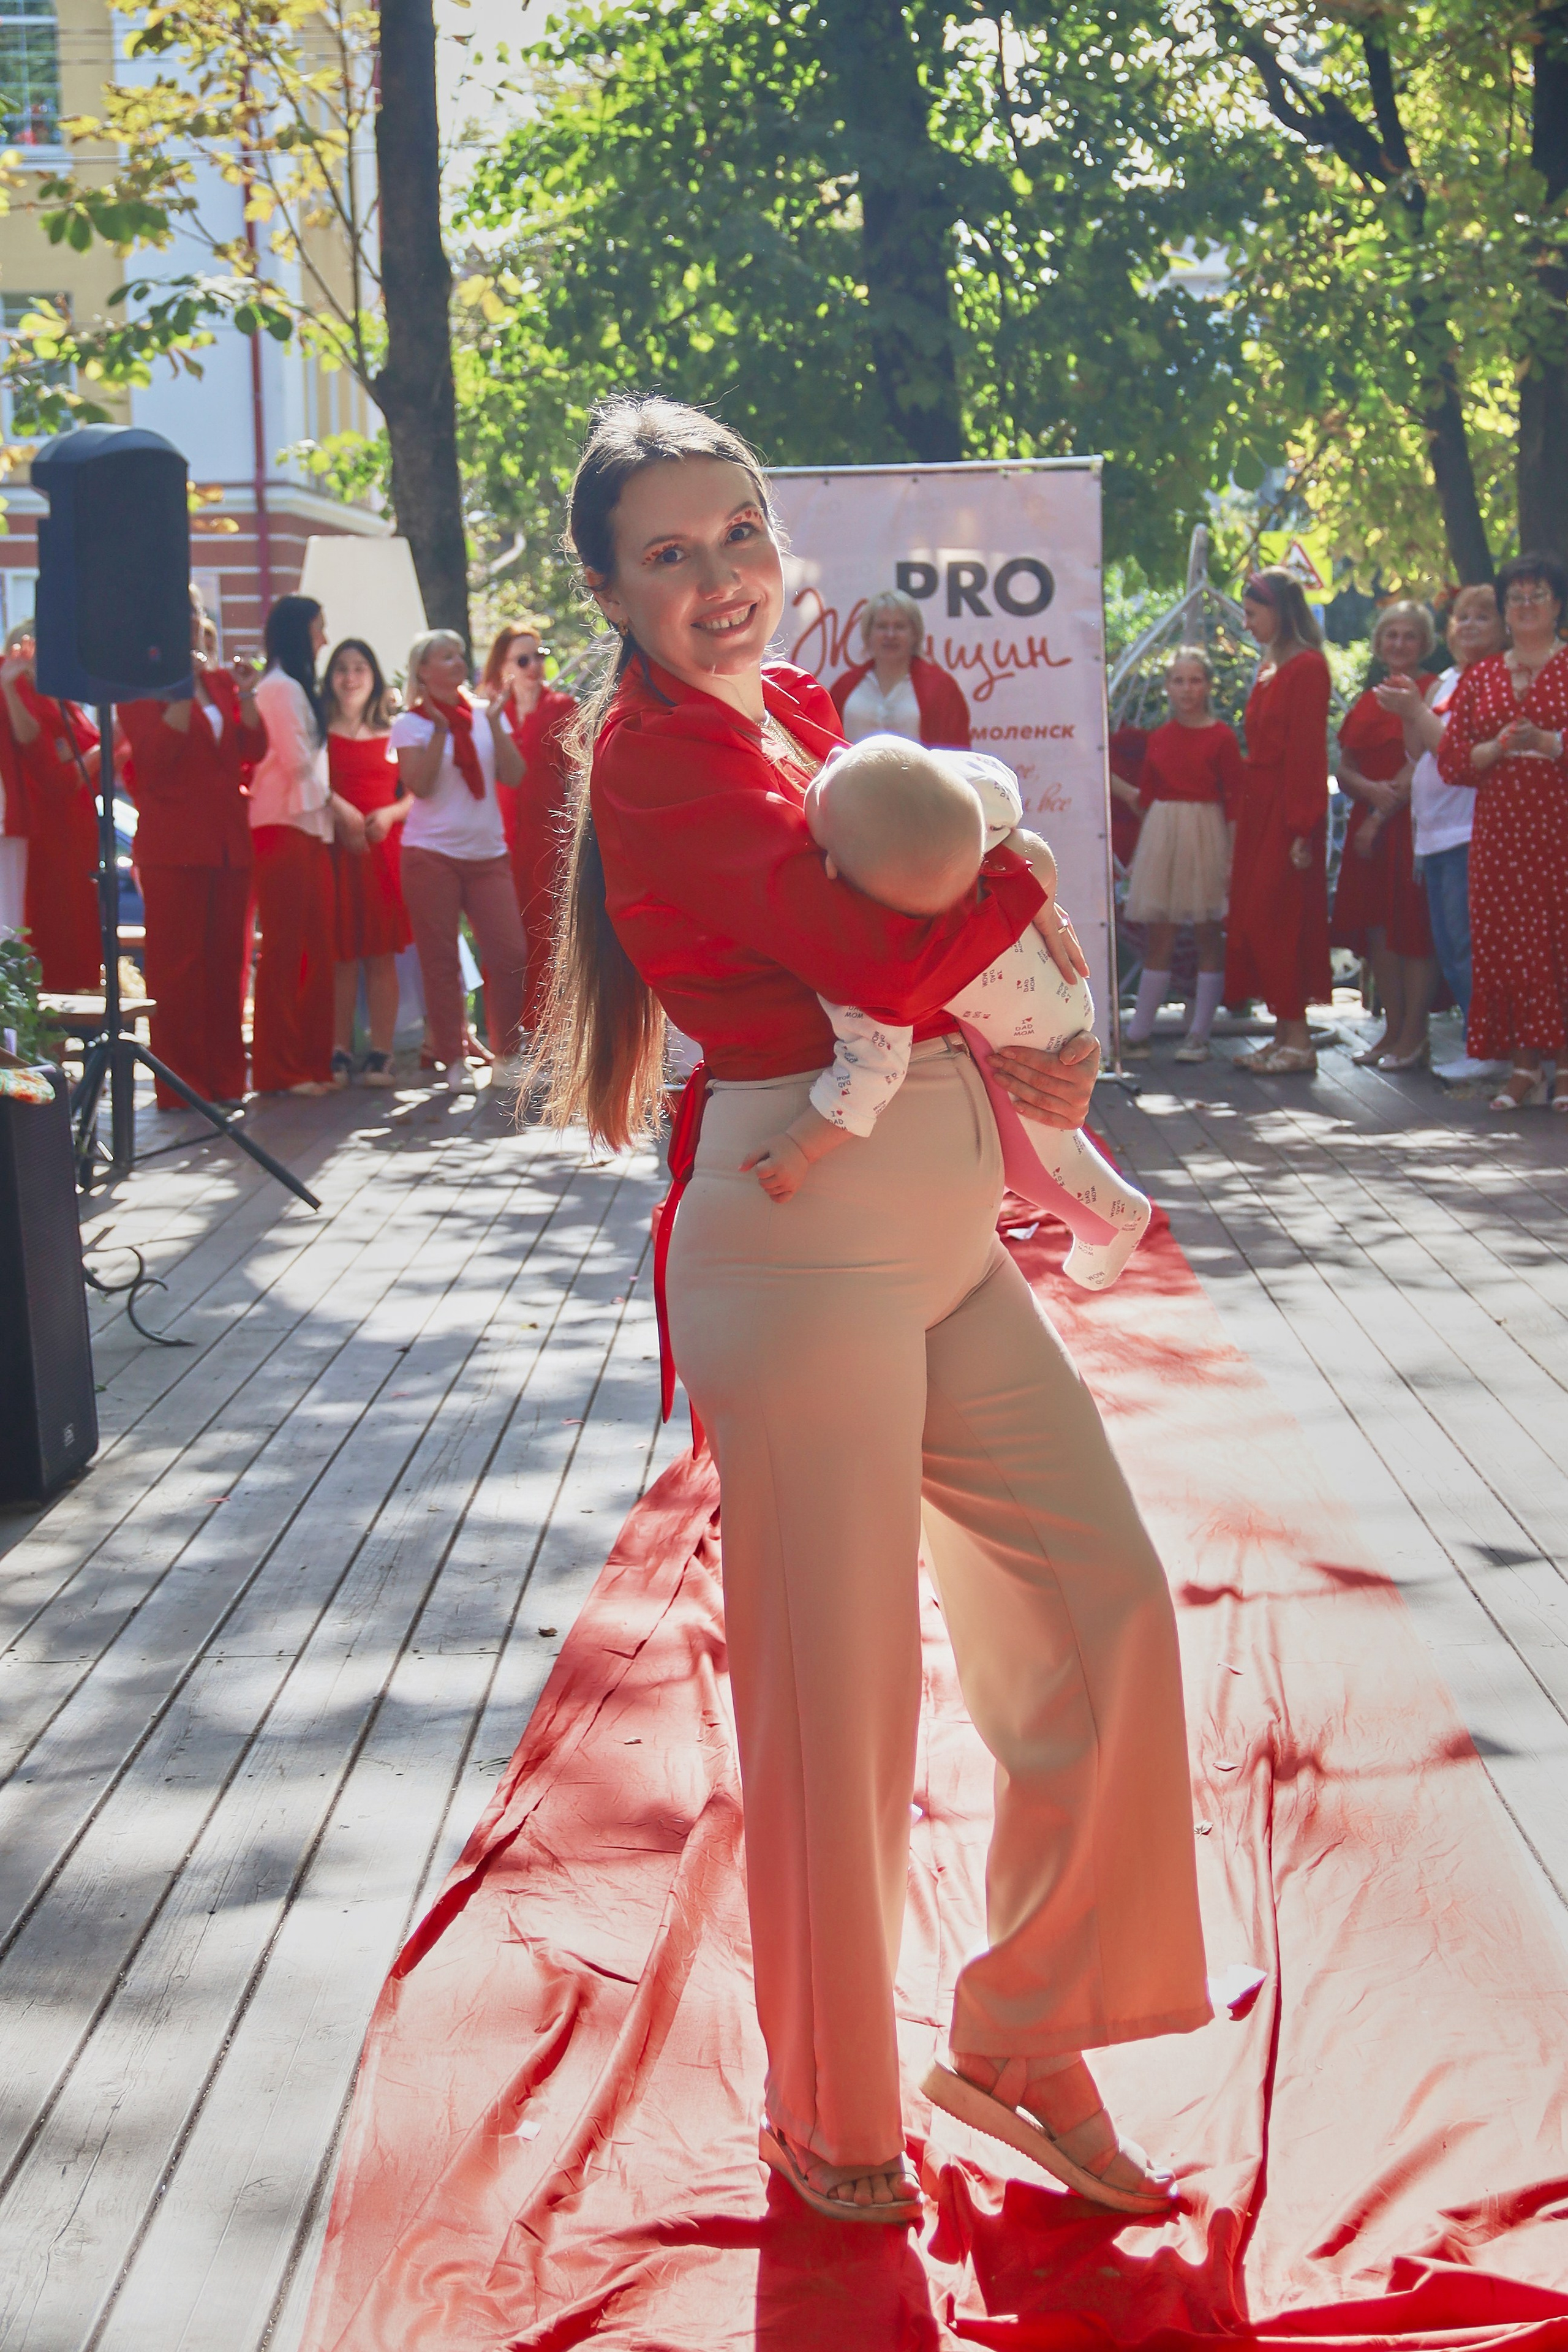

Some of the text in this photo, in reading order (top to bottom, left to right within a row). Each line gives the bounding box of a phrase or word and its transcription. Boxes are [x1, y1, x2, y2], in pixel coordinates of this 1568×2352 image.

[896, 557, 1055, 617] PRO
[970, 724, 1075, 741] моленск
[1055, 982, 1065, 995] MOM
